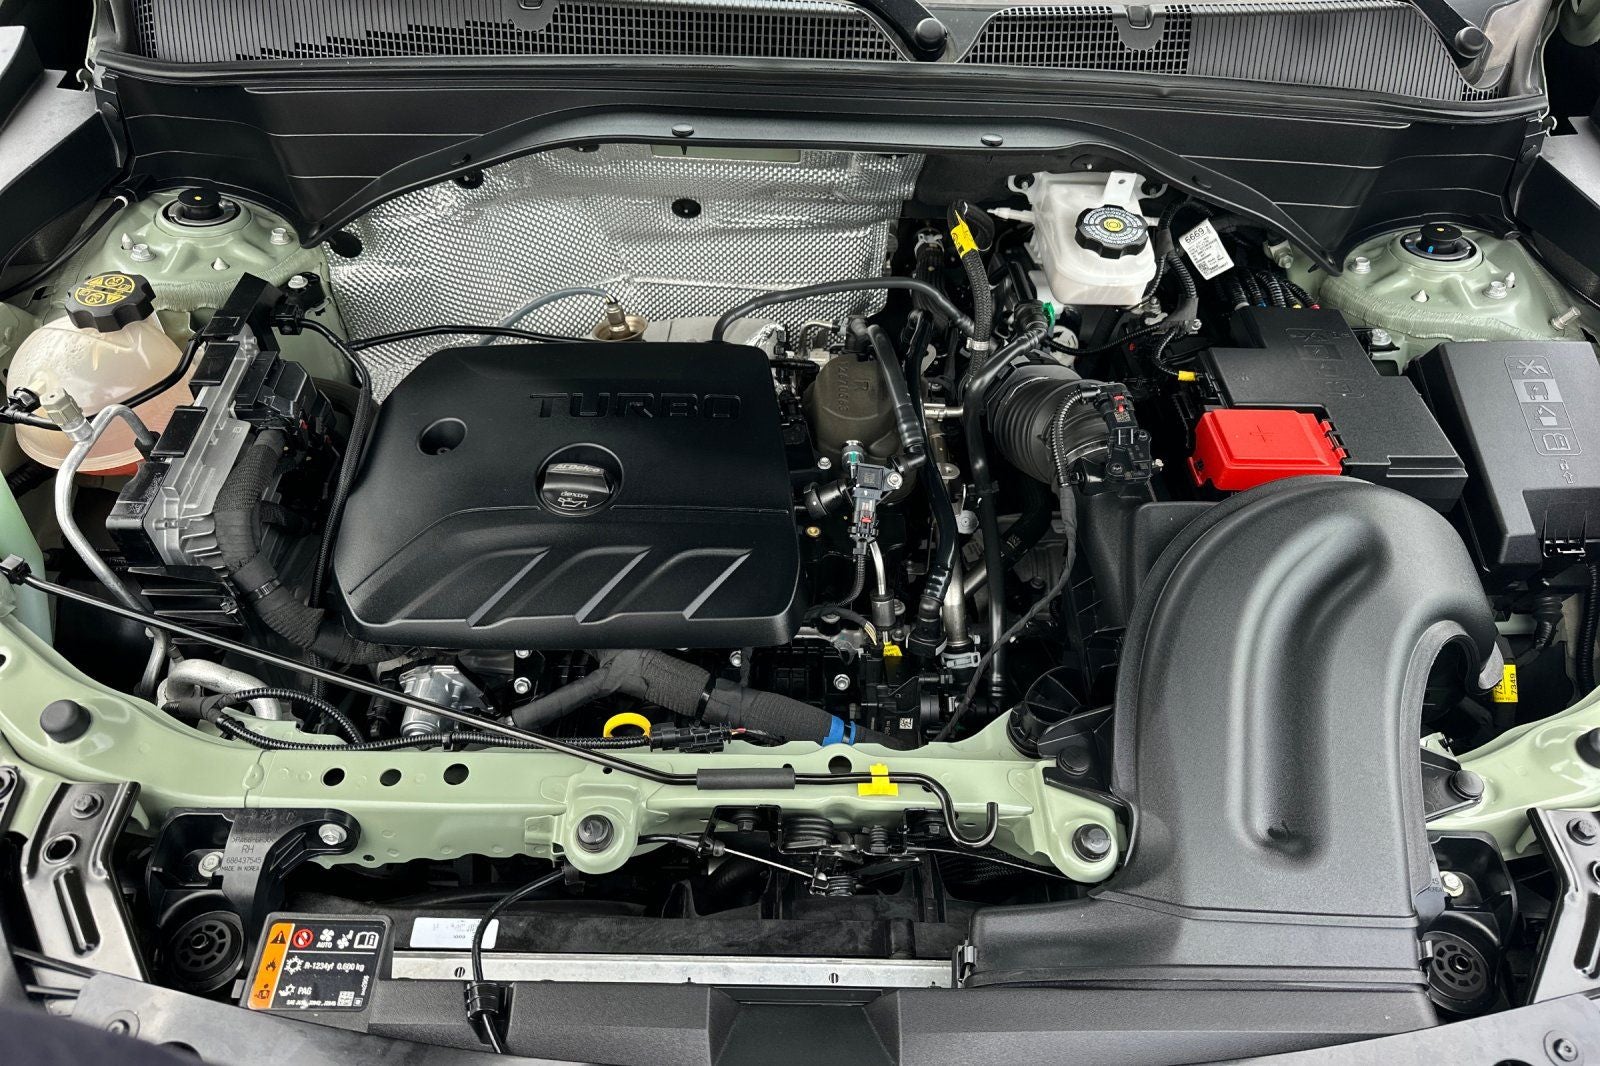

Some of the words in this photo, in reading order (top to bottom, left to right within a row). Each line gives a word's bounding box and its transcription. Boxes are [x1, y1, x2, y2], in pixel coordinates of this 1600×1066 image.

[529, 392, 744, 419] TURBO
[552, 463, 601, 473] ACDelco
[560, 491, 589, 499] dexos
[1509, 673, 1517, 696] 7349
[241, 844, 255, 854] RH
[303, 961, 335, 972] R-1234yf
[355, 963, 365, 973] kg
[297, 986, 313, 995] PAG
